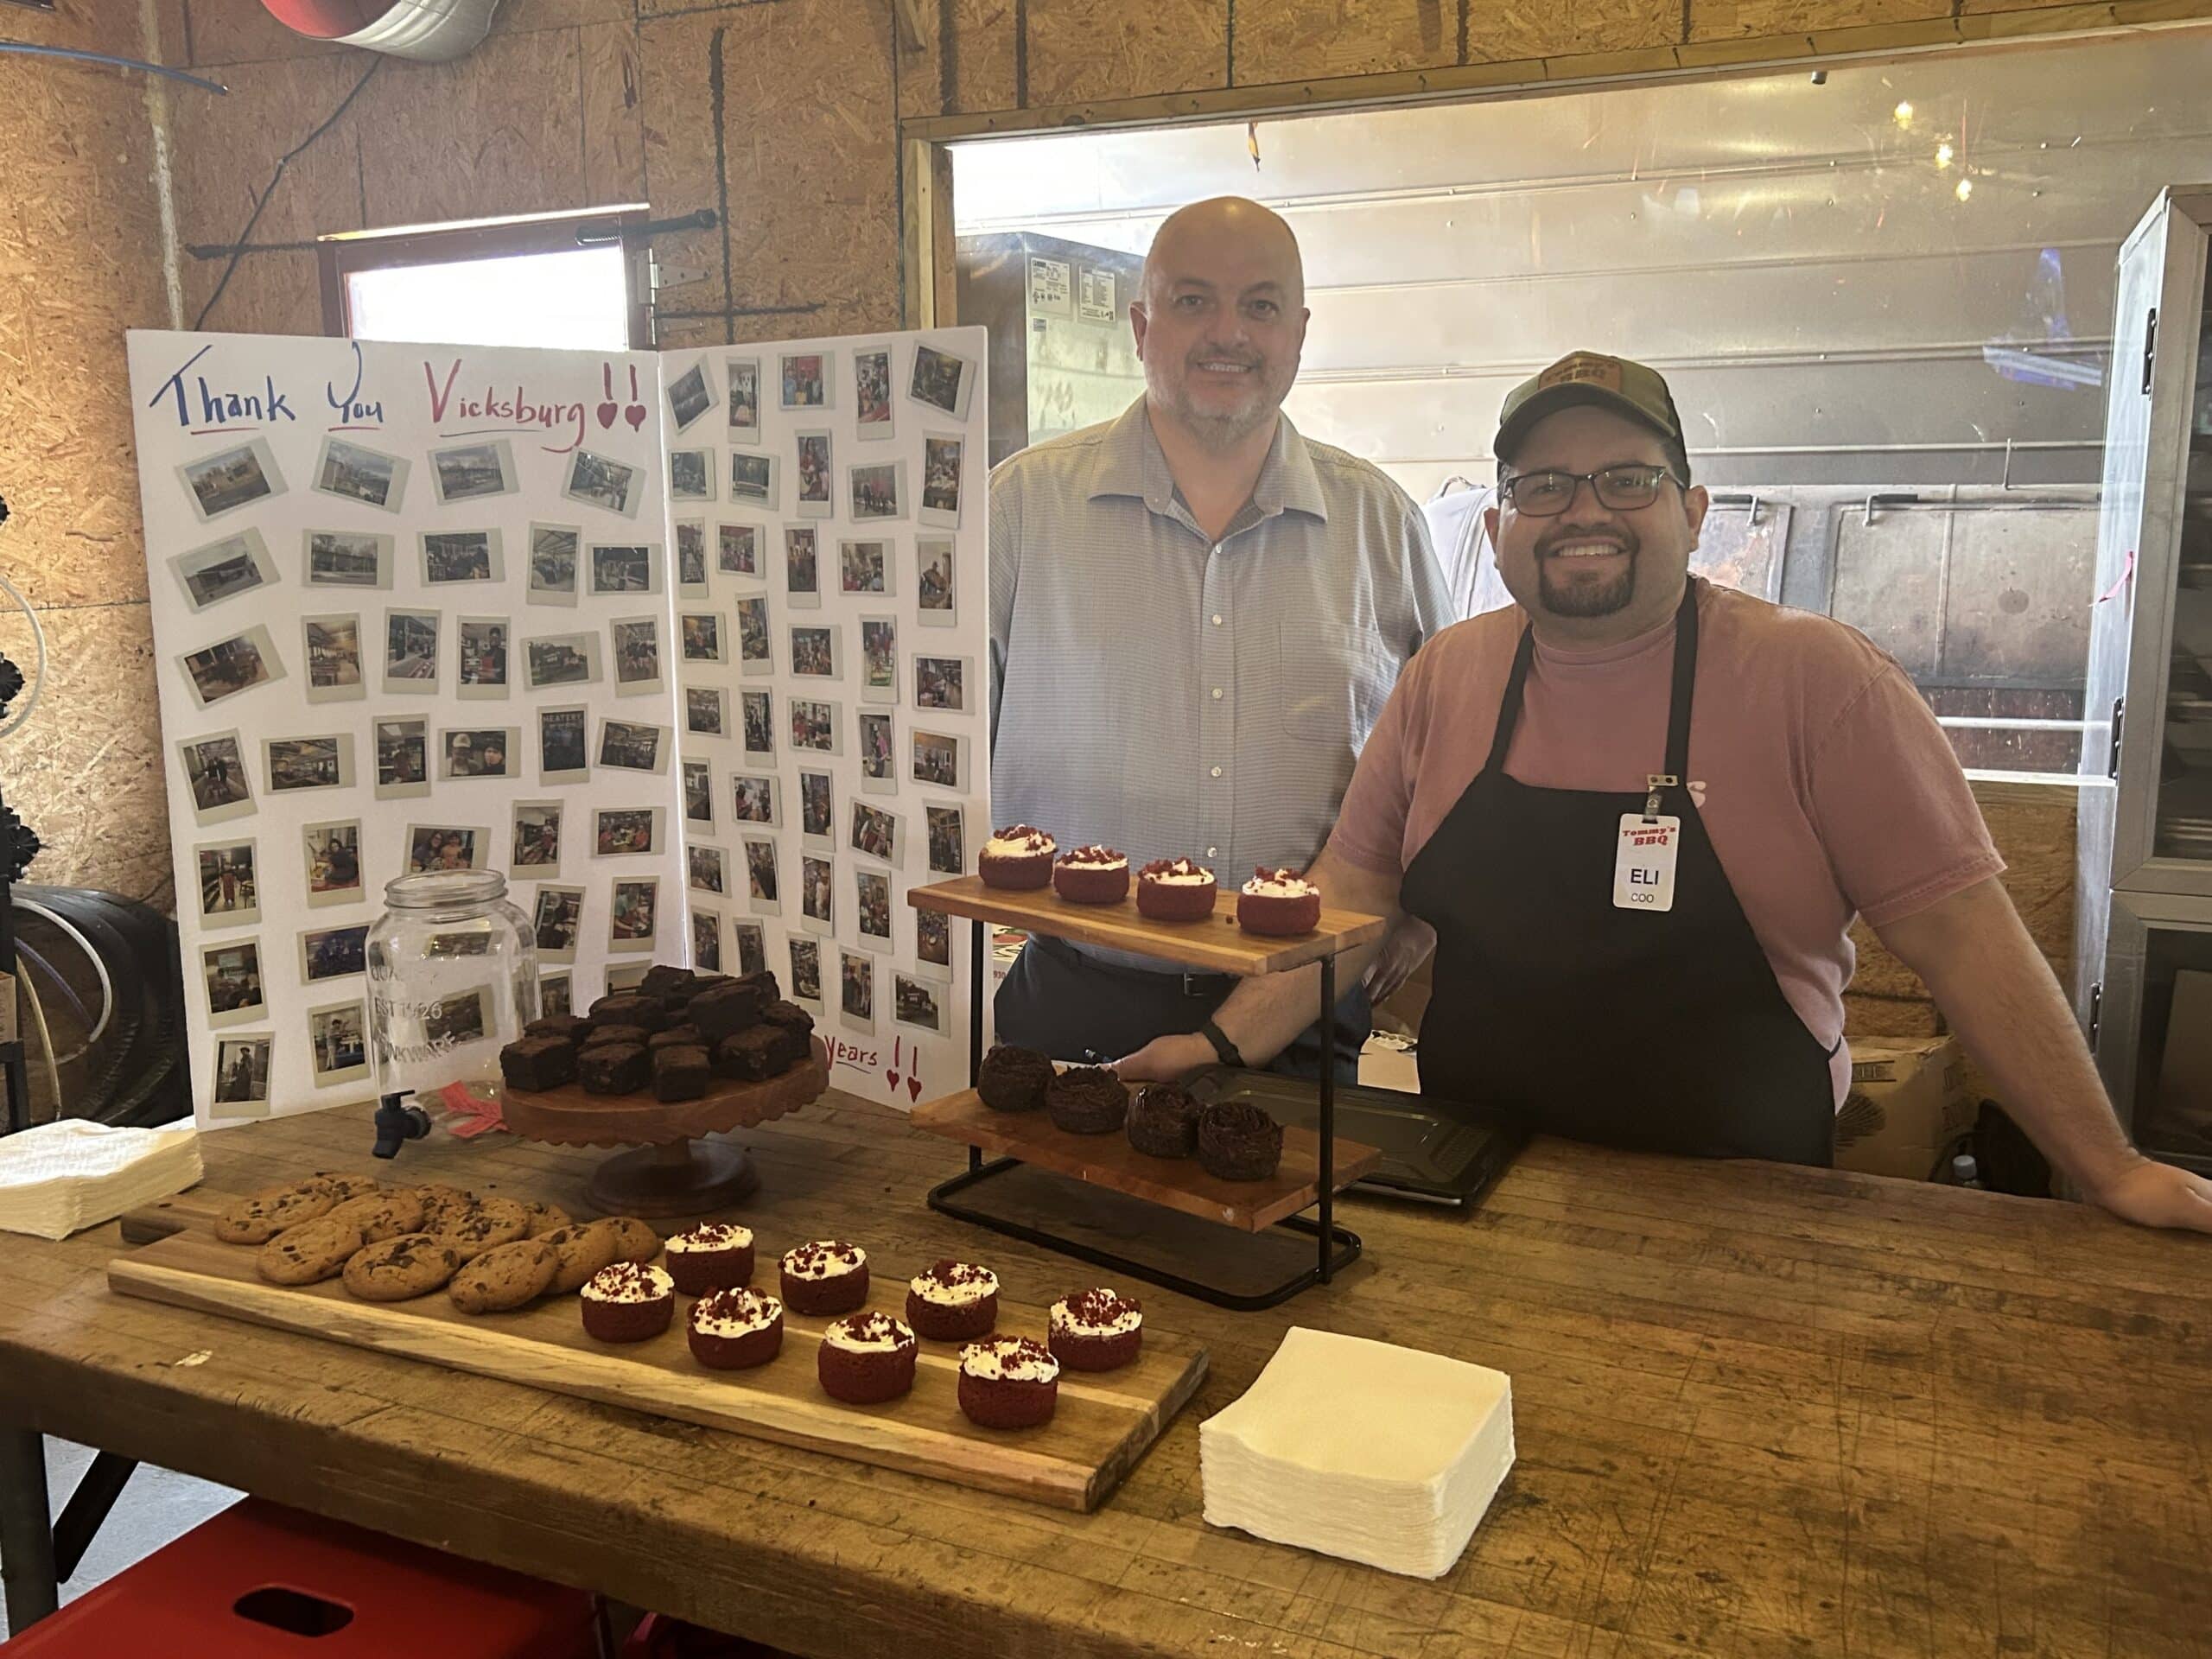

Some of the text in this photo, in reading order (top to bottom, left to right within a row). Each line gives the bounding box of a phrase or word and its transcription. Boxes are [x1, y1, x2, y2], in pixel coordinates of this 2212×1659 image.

[149, 344, 296, 426] Thank
[327, 340, 384, 423] You
[1633, 836, 1668, 846] BBQ
[1630, 868, 1659, 885] ELI
[1630, 893, 1654, 903] COO
